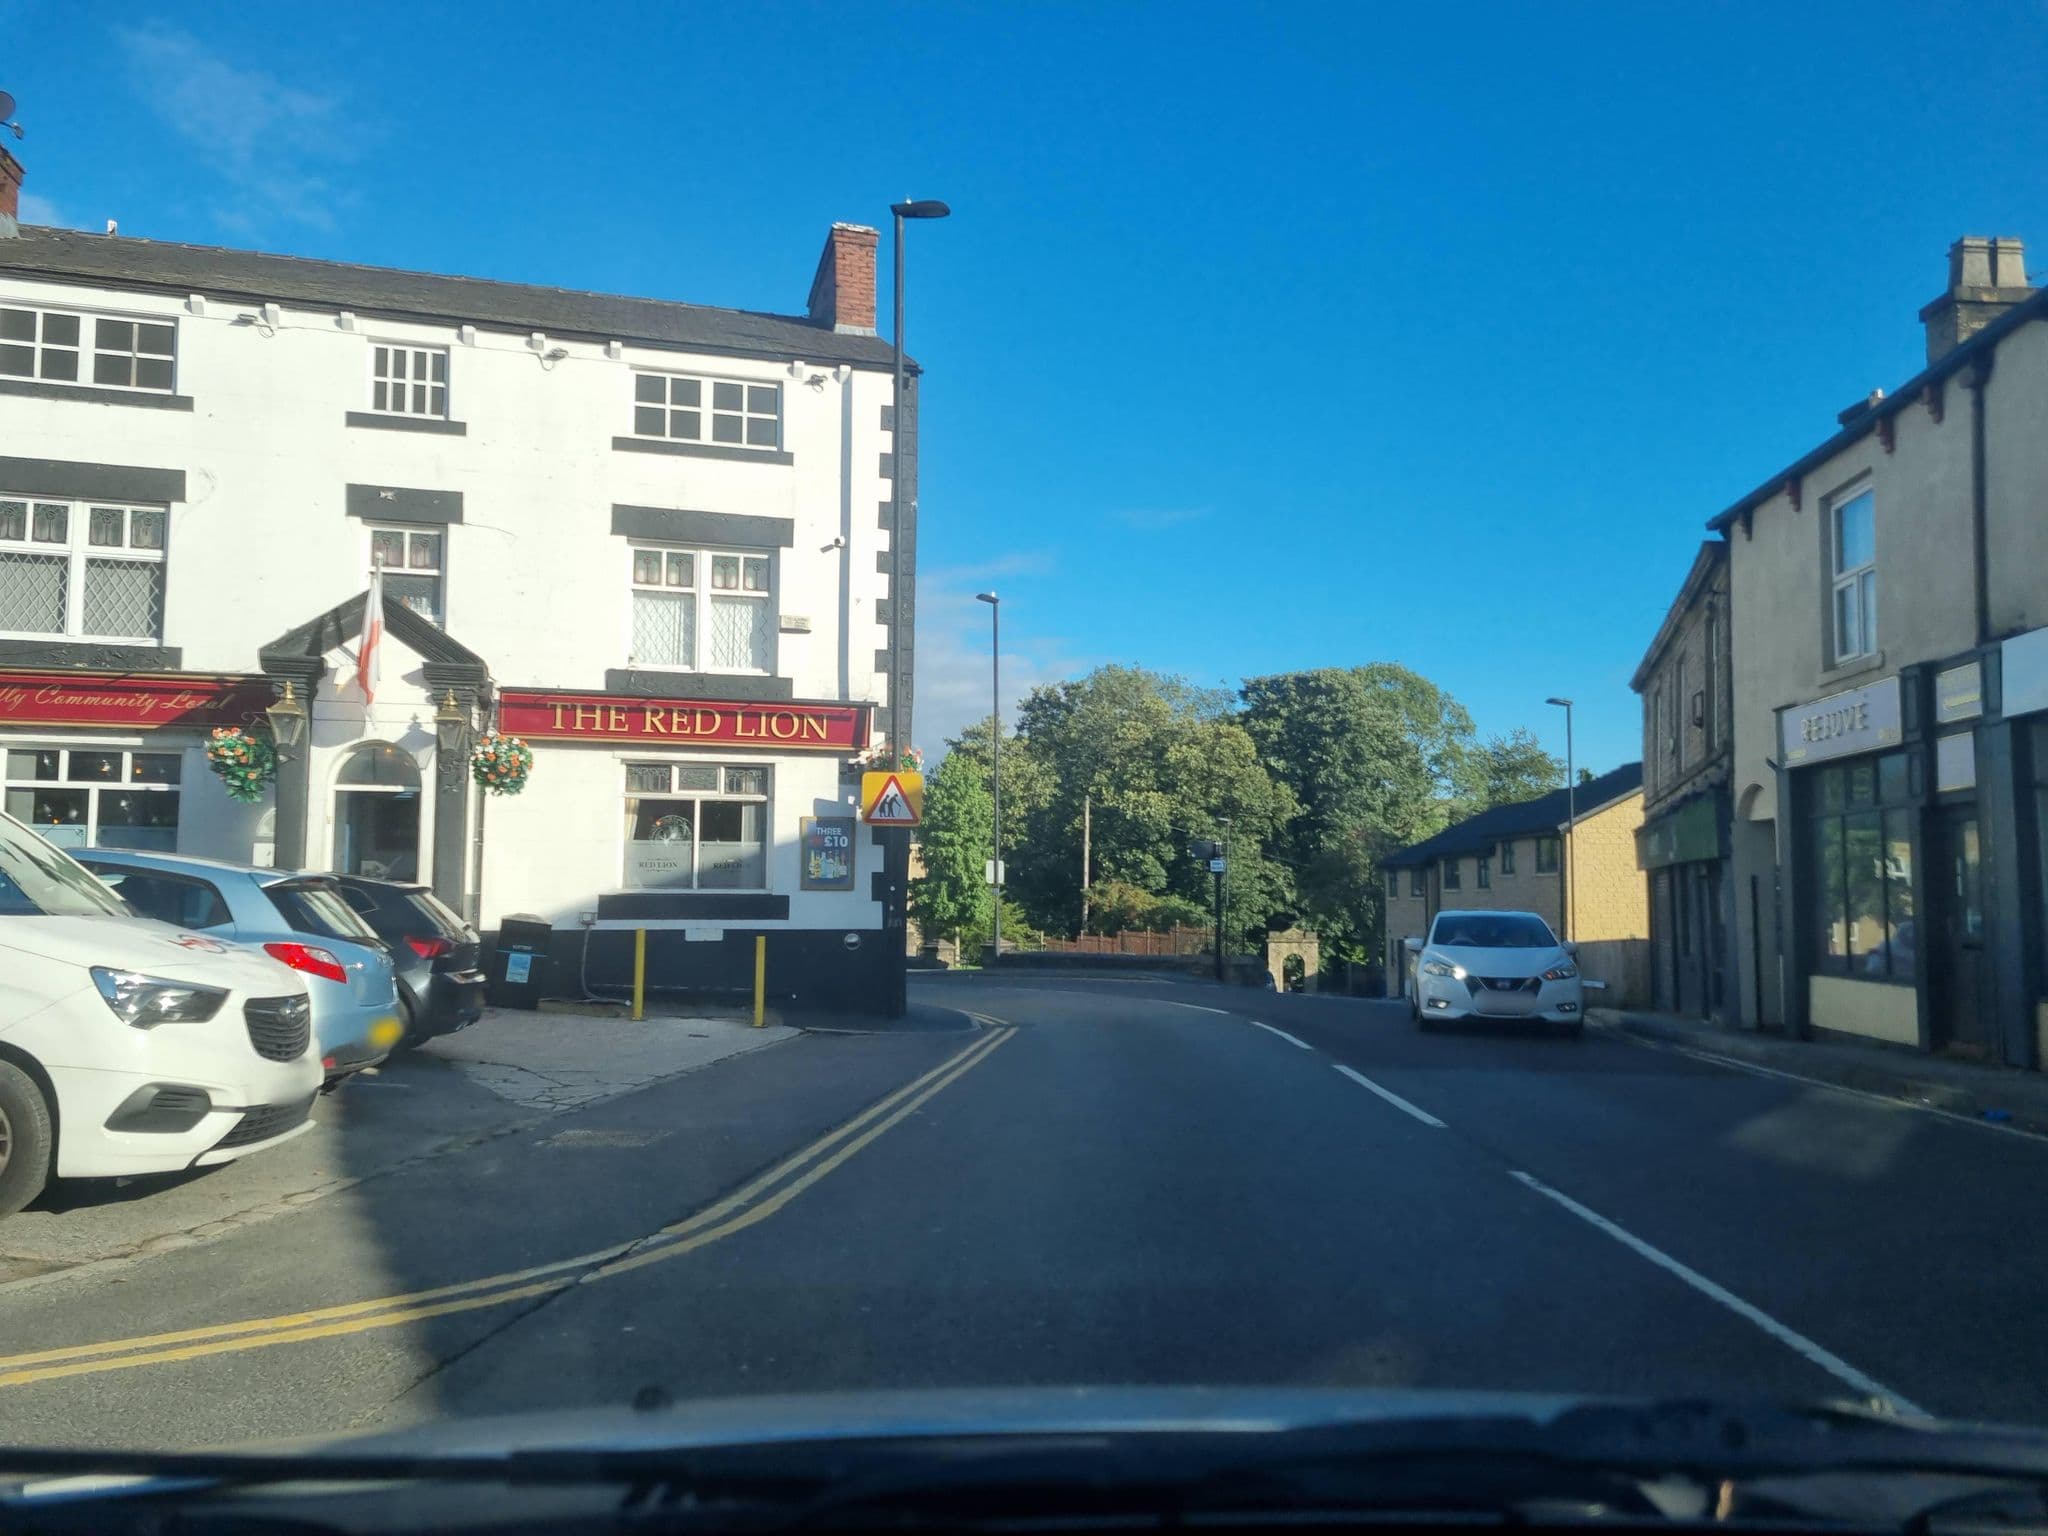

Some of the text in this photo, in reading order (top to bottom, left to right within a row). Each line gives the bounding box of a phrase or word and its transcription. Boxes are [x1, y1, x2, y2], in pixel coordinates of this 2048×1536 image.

[35, 684, 159, 716] Community
[160, 690, 236, 710] Local
[547, 702, 829, 740] THE RED LION
[817, 827, 842, 836] THREE
[824, 836, 849, 847] £10
